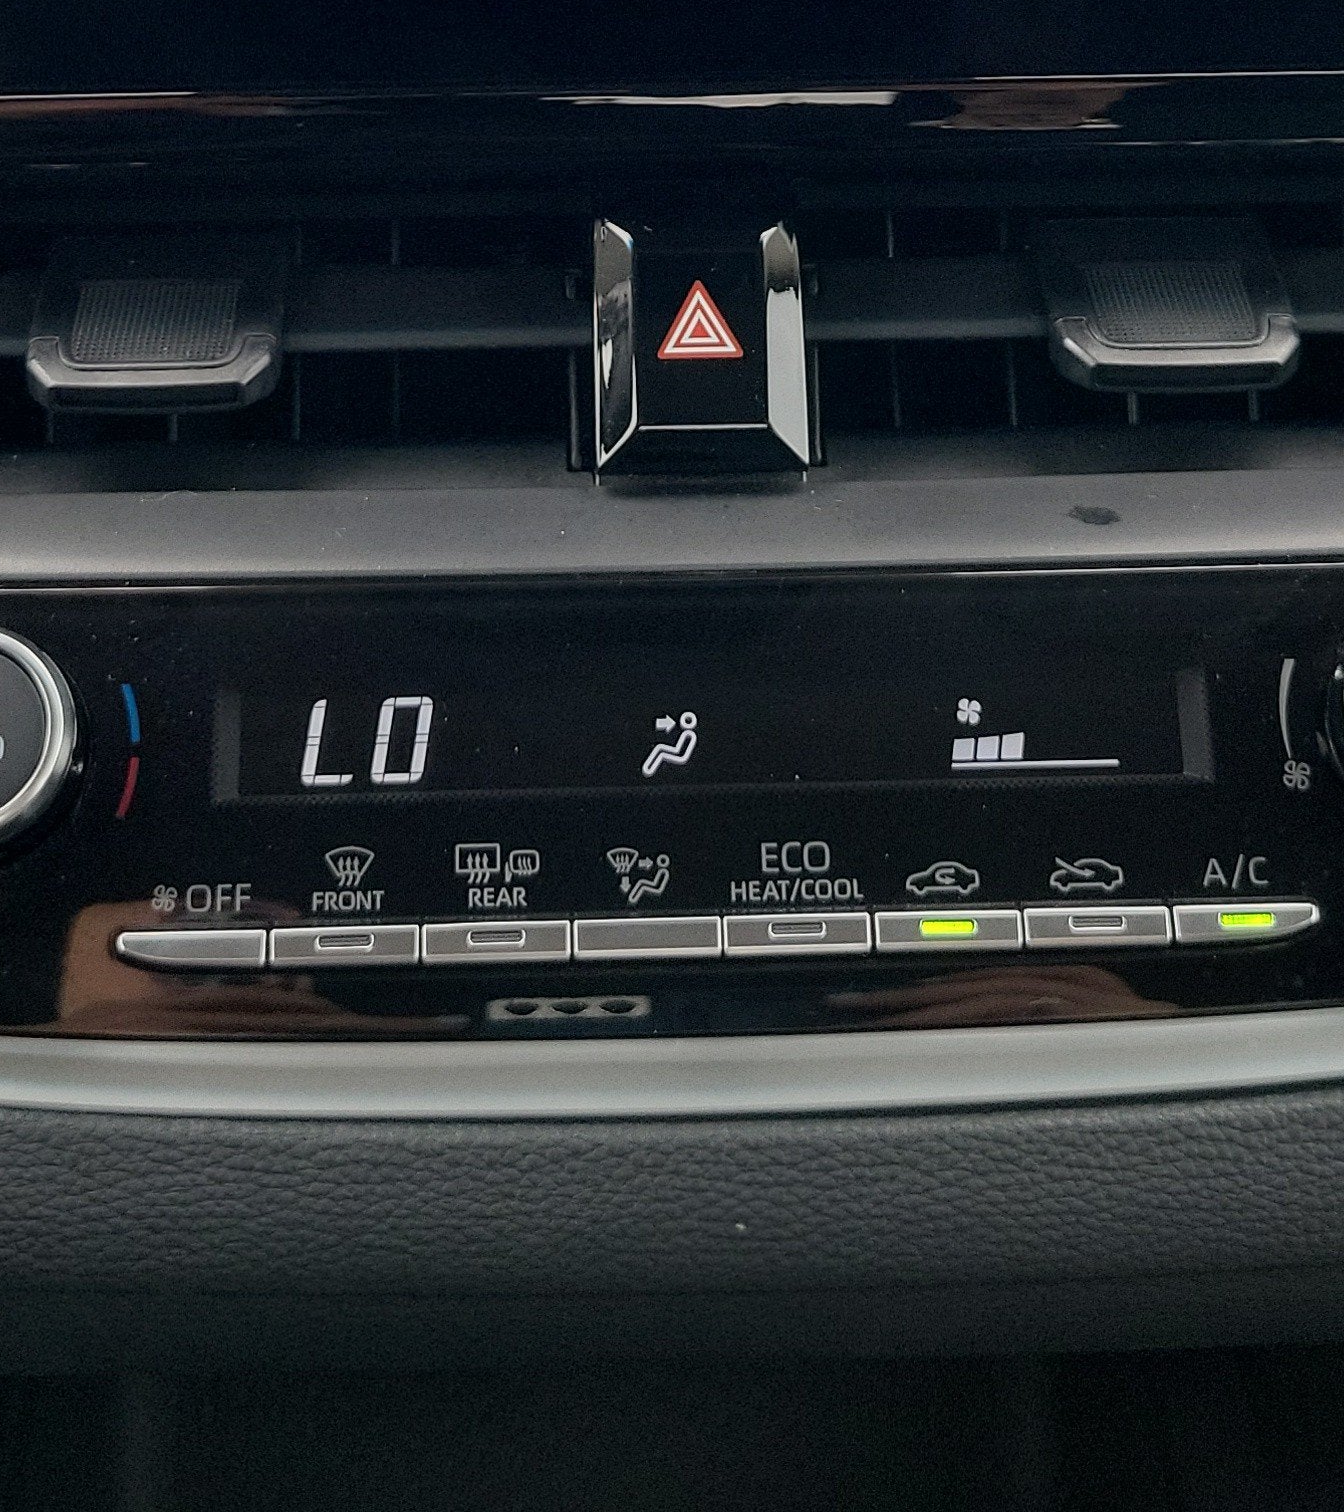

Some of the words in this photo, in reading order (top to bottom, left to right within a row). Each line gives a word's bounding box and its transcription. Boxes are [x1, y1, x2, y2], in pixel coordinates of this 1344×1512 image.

[760, 840, 831, 874] ECO
[1202, 853, 1269, 890] A/C
[185, 883, 253, 912] OFF
[311, 890, 385, 912] FRONT
[468, 886, 528, 908] REAR
[730, 877, 864, 903] HEAT/COOL
